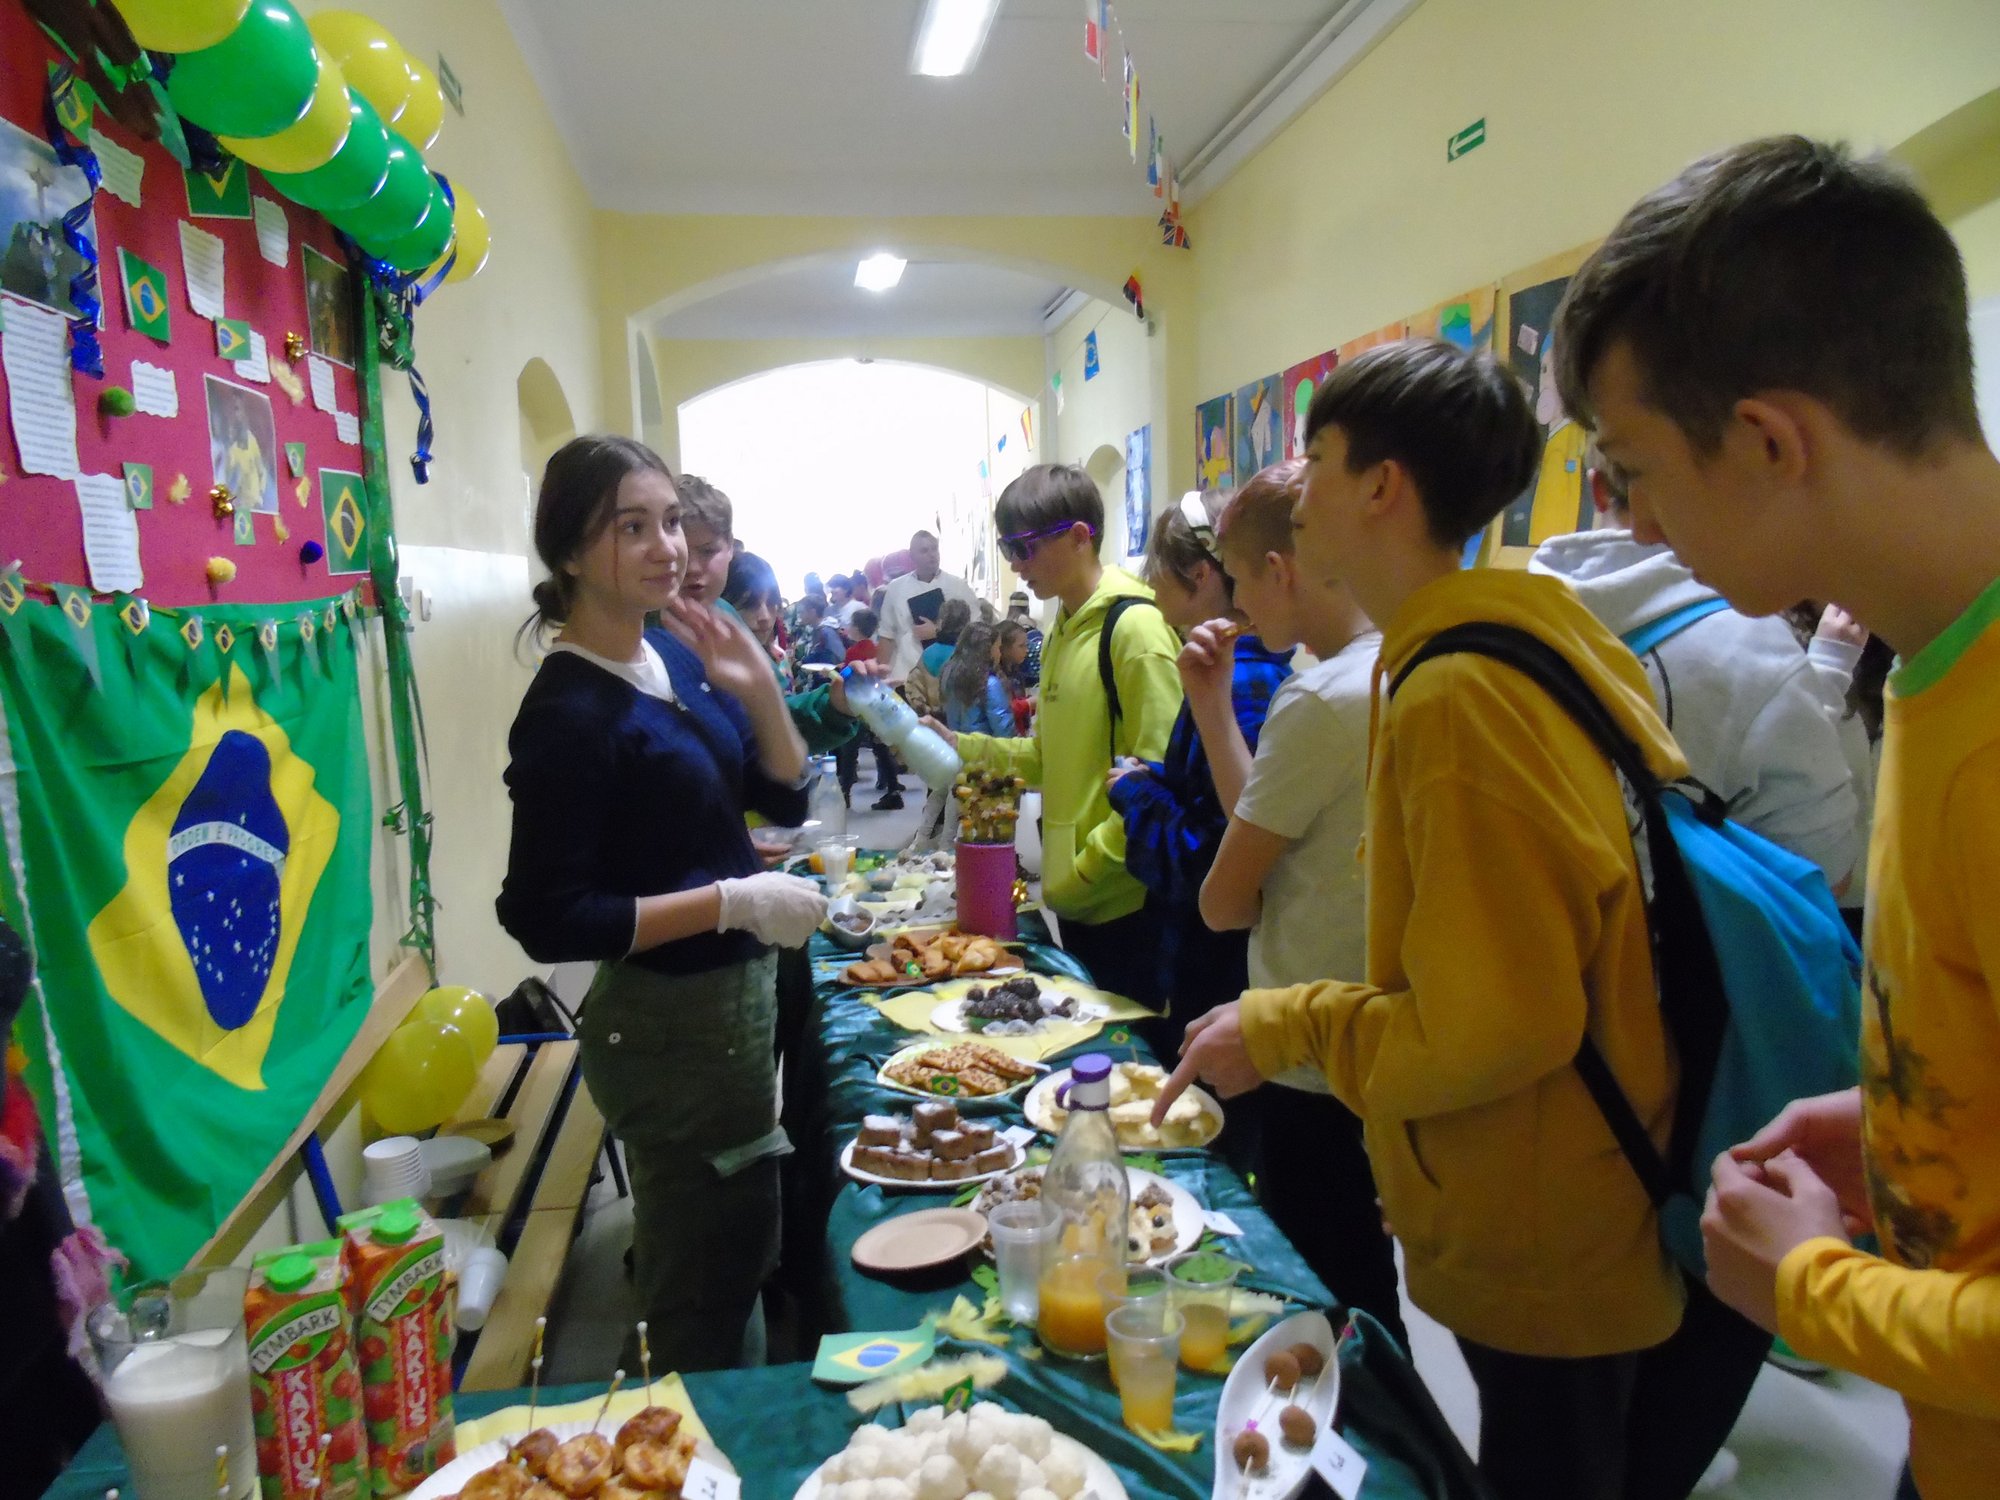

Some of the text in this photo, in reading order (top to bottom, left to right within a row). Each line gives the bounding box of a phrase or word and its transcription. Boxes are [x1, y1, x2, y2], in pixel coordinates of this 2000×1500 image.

[371, 1252, 444, 1315] TYMBARK
[251, 1308, 337, 1366] TYMBARK
[403, 1312, 427, 1427] KAKTUS
[284, 1369, 316, 1489] KAKTUS
